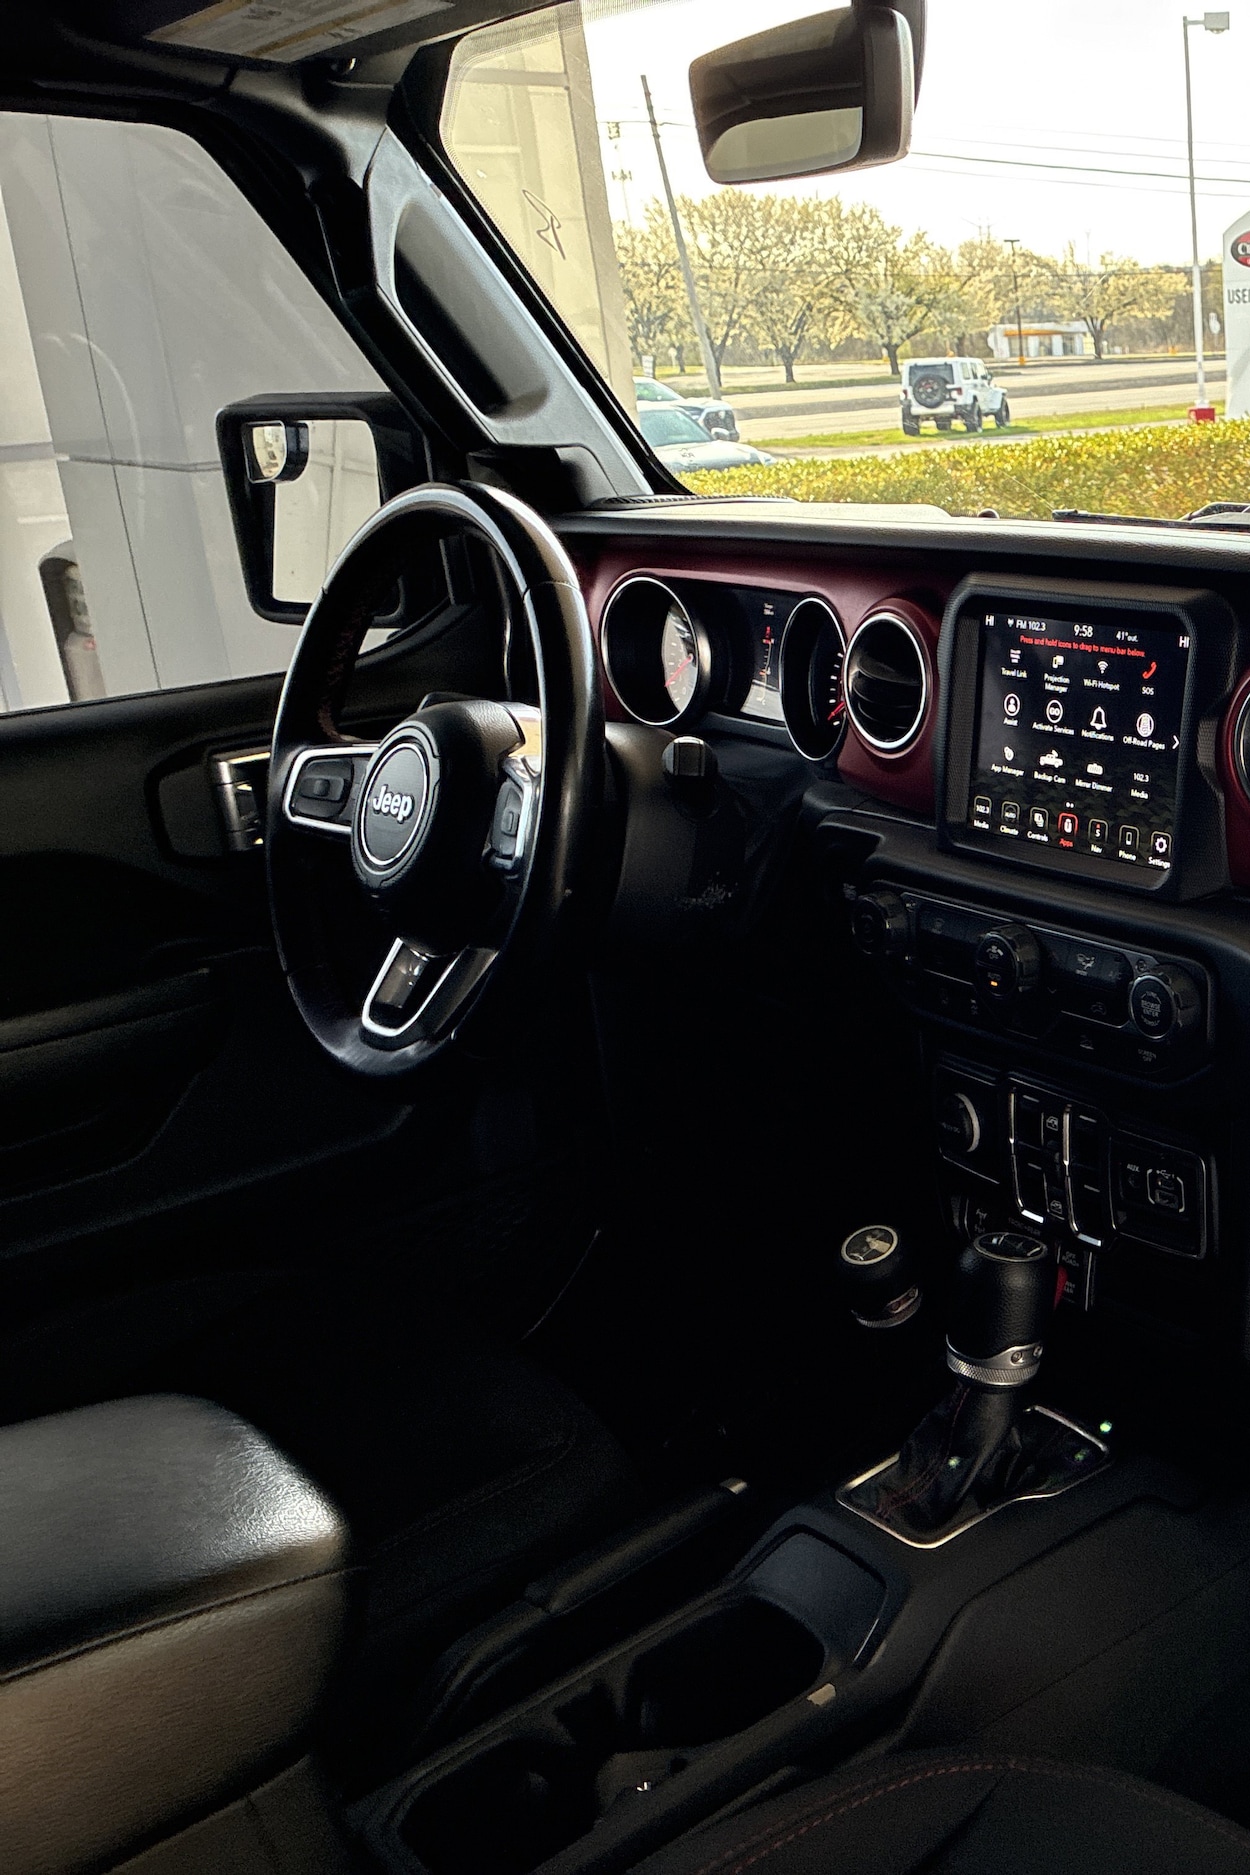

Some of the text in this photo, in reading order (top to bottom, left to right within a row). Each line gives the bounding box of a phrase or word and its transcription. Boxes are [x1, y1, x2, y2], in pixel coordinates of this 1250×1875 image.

[985, 615, 994, 627] HI
[1028, 621, 1046, 632] 102.3
[1074, 625, 1093, 638] 9:58
[1020, 635, 1033, 645] Press
[1034, 637, 1044, 646] and
[1073, 641, 1079, 650] to
[1080, 642, 1092, 653] drag
[1093, 644, 1099, 653] to
[1100, 645, 1116, 655] menu
[1117, 646, 1126, 656] bar
[1179, 636, 1190, 648] HI
[1016, 669, 1027, 679] Link
[1044, 673, 1070, 684] Projection
[1045, 682, 1068, 693] Manager
[1098, 681, 1120, 691] Hotspot
[1142, 687, 1154, 696] SOS
[1032, 722, 1075, 736] Activate Services
[1081, 729, 1114, 742] Notifications
[1123, 736, 1166, 751] Off-Road Pages
[991, 764, 1024, 777] App Manager
[1034, 771, 1066, 785] Backup Cam
[1133, 773, 1149, 783] 102.3
[1075, 779, 1113, 793] Mirror Dimmer
[1131, 789, 1149, 799] Media
[373, 785, 413, 823] Jeep
[1000, 825, 1019, 836] Climate
[1027, 831, 1049, 843] Controls
[1059, 838, 1073, 848] Apps
[1091, 844, 1102, 853] Nav
[1119, 850, 1136, 861] Phone
[1148, 856, 1171, 869] Settings
